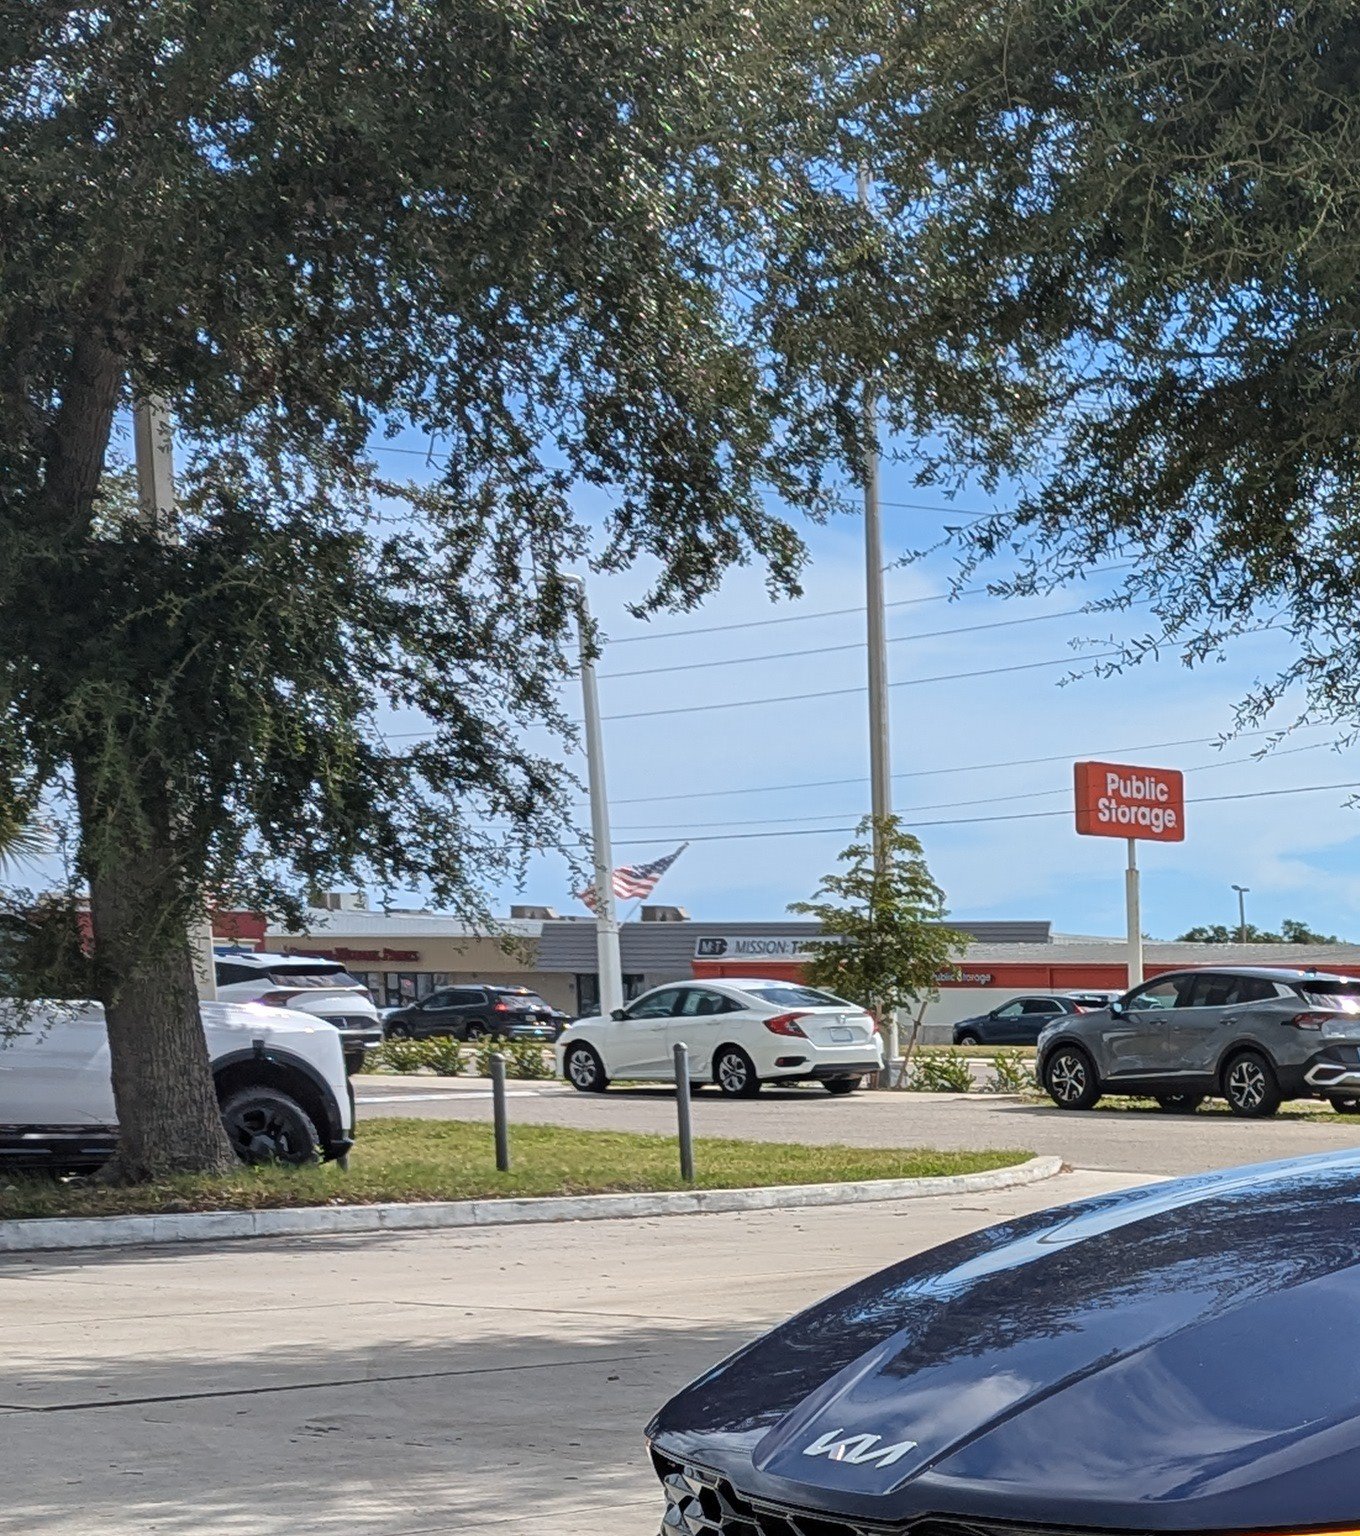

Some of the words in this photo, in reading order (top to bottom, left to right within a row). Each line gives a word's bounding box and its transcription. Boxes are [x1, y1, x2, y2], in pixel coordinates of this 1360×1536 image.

[1106, 773, 1169, 801] Public
[1098, 798, 1176, 833] Storage
[803, 1428, 918, 1469] KIA
